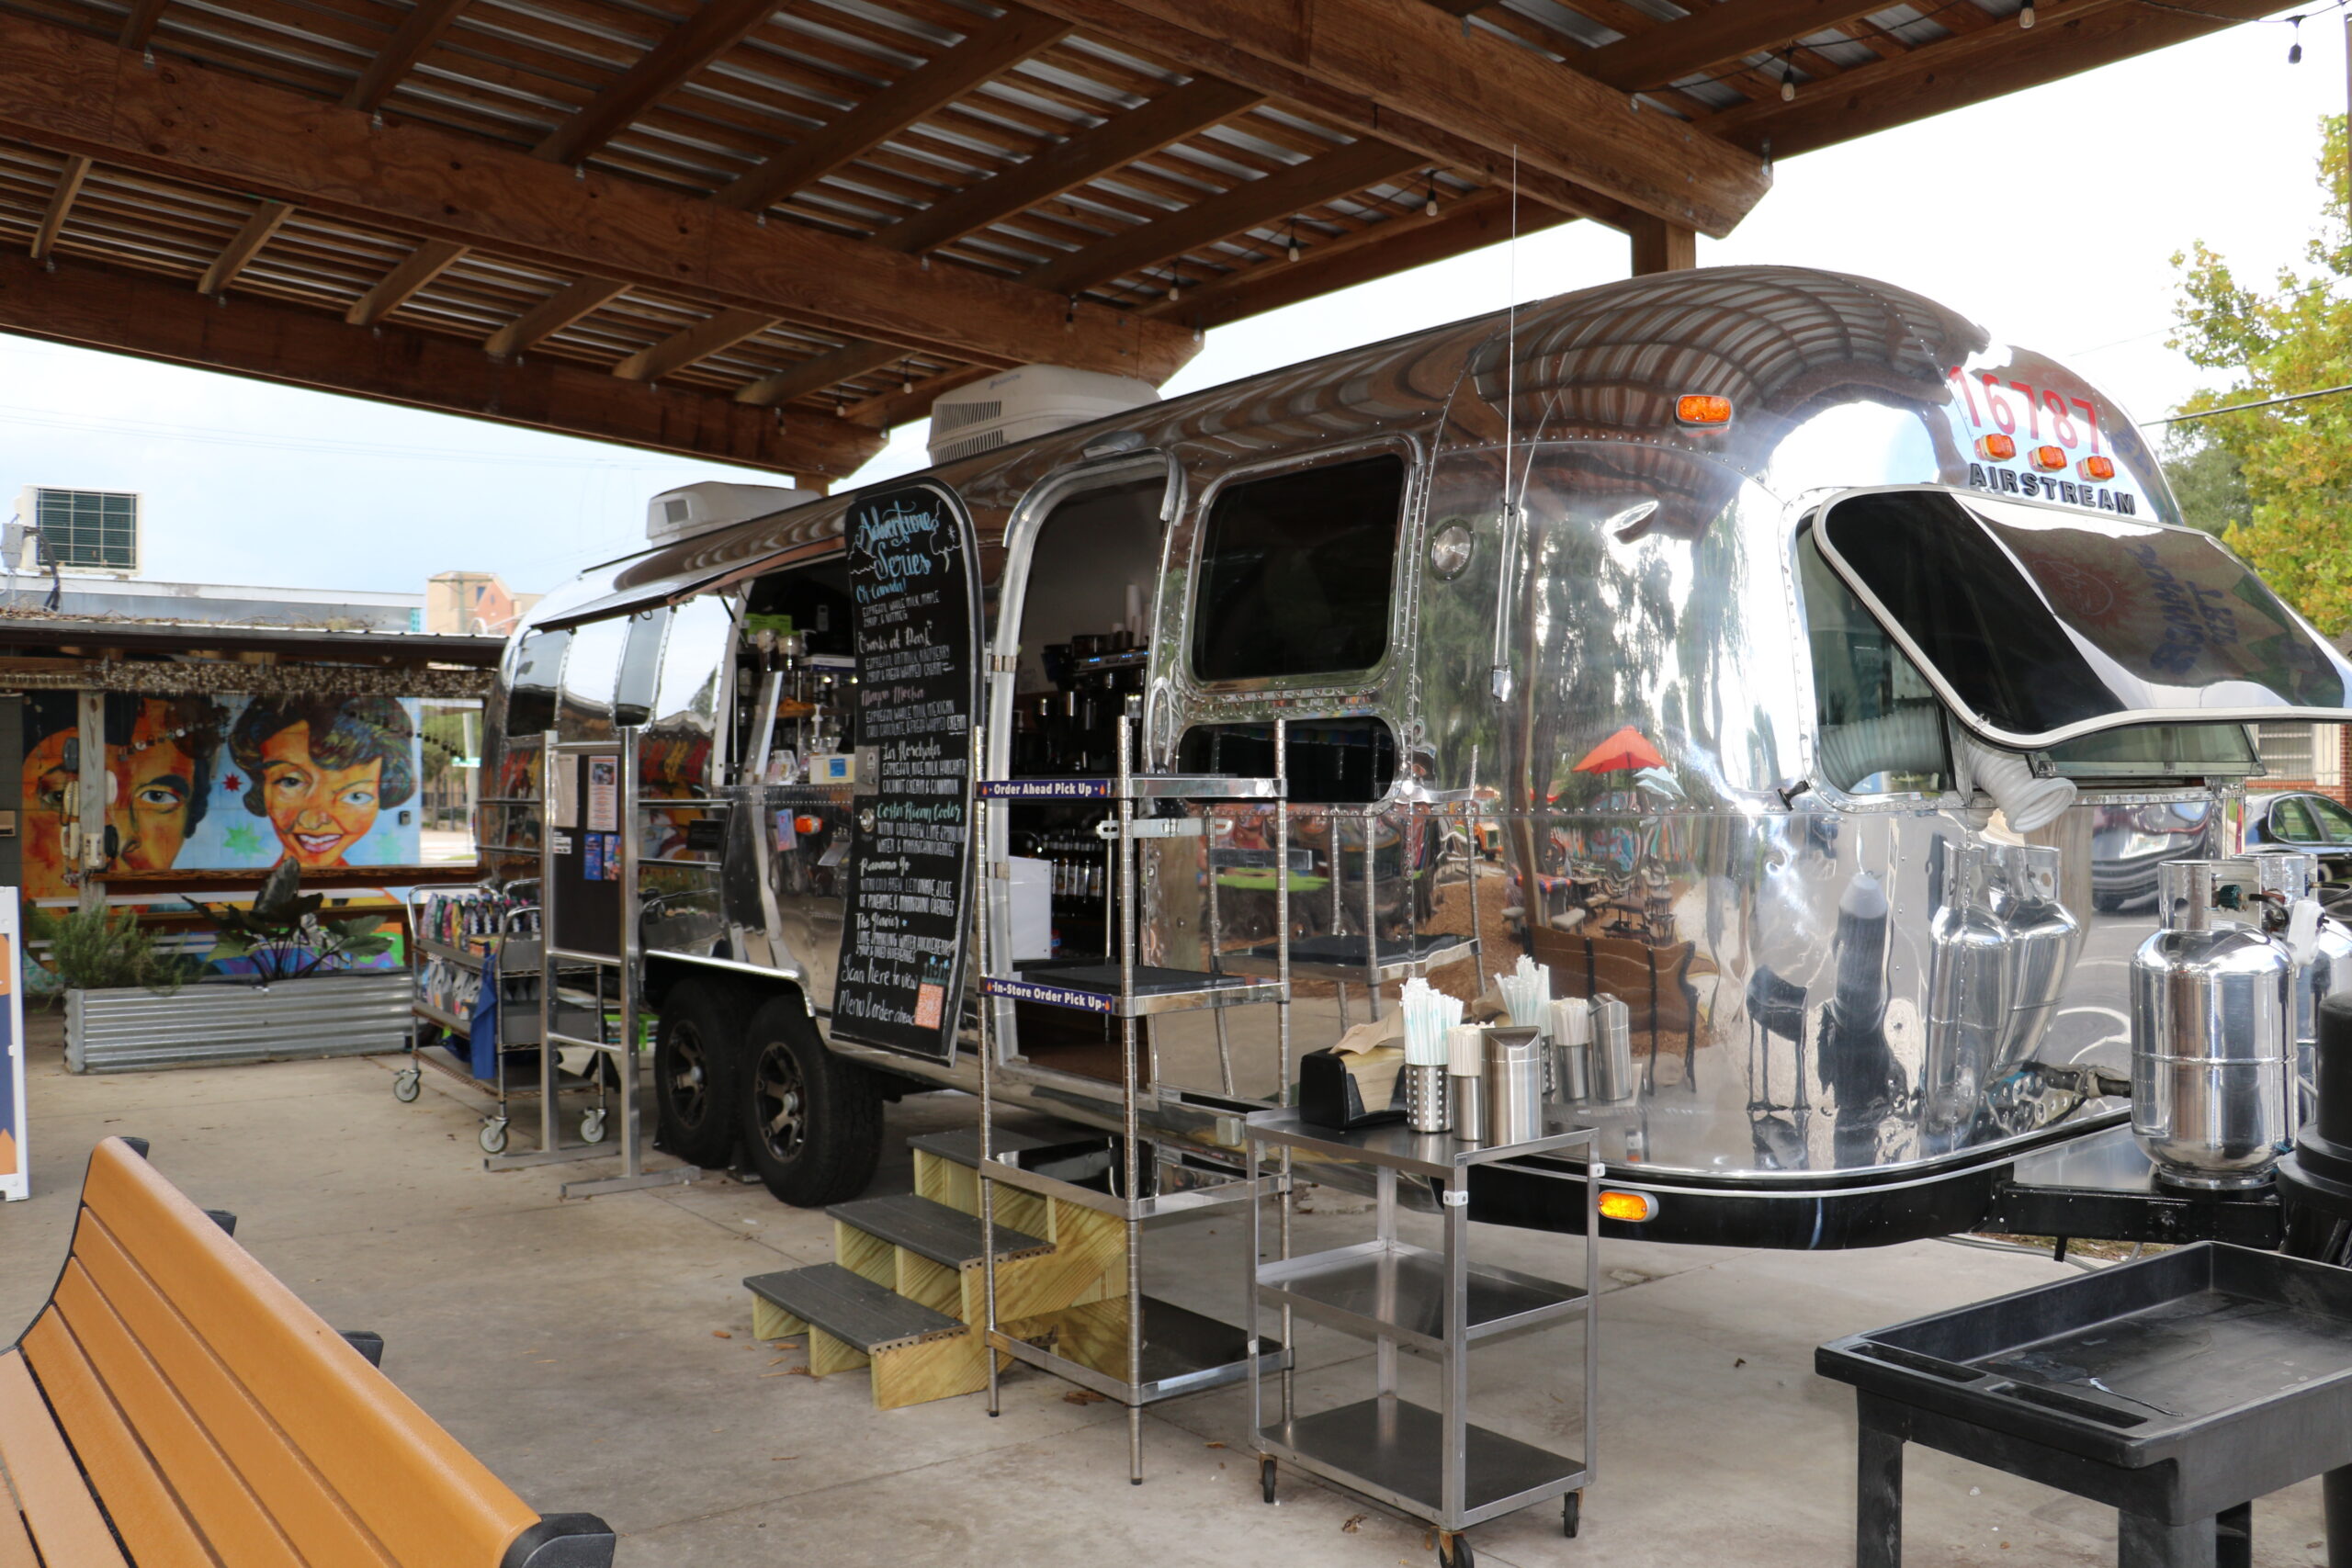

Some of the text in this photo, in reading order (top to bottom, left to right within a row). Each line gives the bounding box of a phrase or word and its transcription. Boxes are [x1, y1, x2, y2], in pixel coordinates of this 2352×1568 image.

[1948, 366, 2099, 454] 16787
[1969, 463, 2136, 514] AIRSTREAM
[855, 501, 937, 554] Adventure
[874, 541, 932, 581] Series
[994, 783, 1091, 796] Order Ahead Pick Up
[854, 913, 870, 930] The
[841, 954, 918, 989] Scan here to view
[838, 989, 865, 1017] Menu
[872, 999, 894, 1021] order
[994, 981, 1102, 1010] In-Store Order Pick Up
